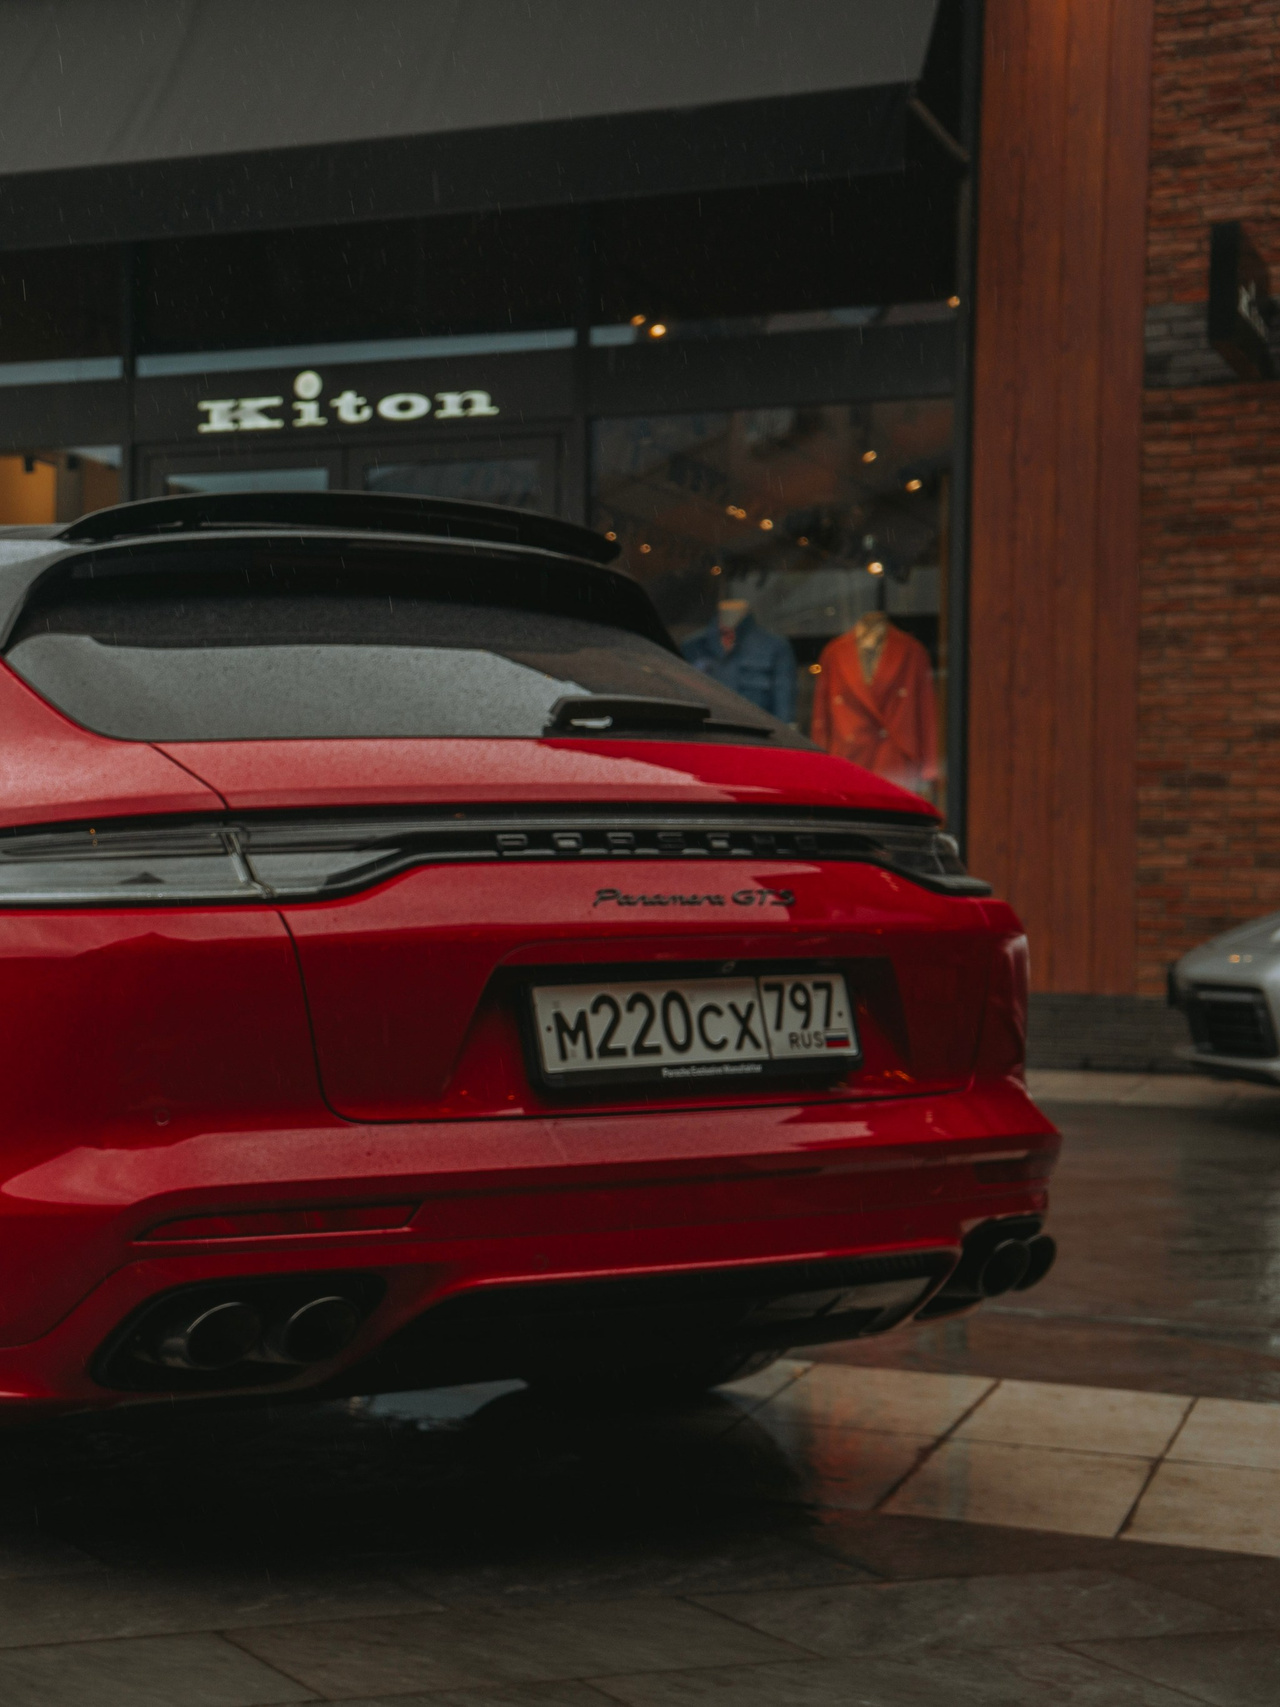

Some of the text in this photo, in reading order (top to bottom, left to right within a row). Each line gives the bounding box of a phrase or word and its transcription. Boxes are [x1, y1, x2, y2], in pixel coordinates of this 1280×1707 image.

[197, 370, 500, 433] Kiton
[593, 888, 796, 907] Panamera GTS
[551, 981, 833, 1061] M220CX 797
[788, 1032, 824, 1050] RUS
